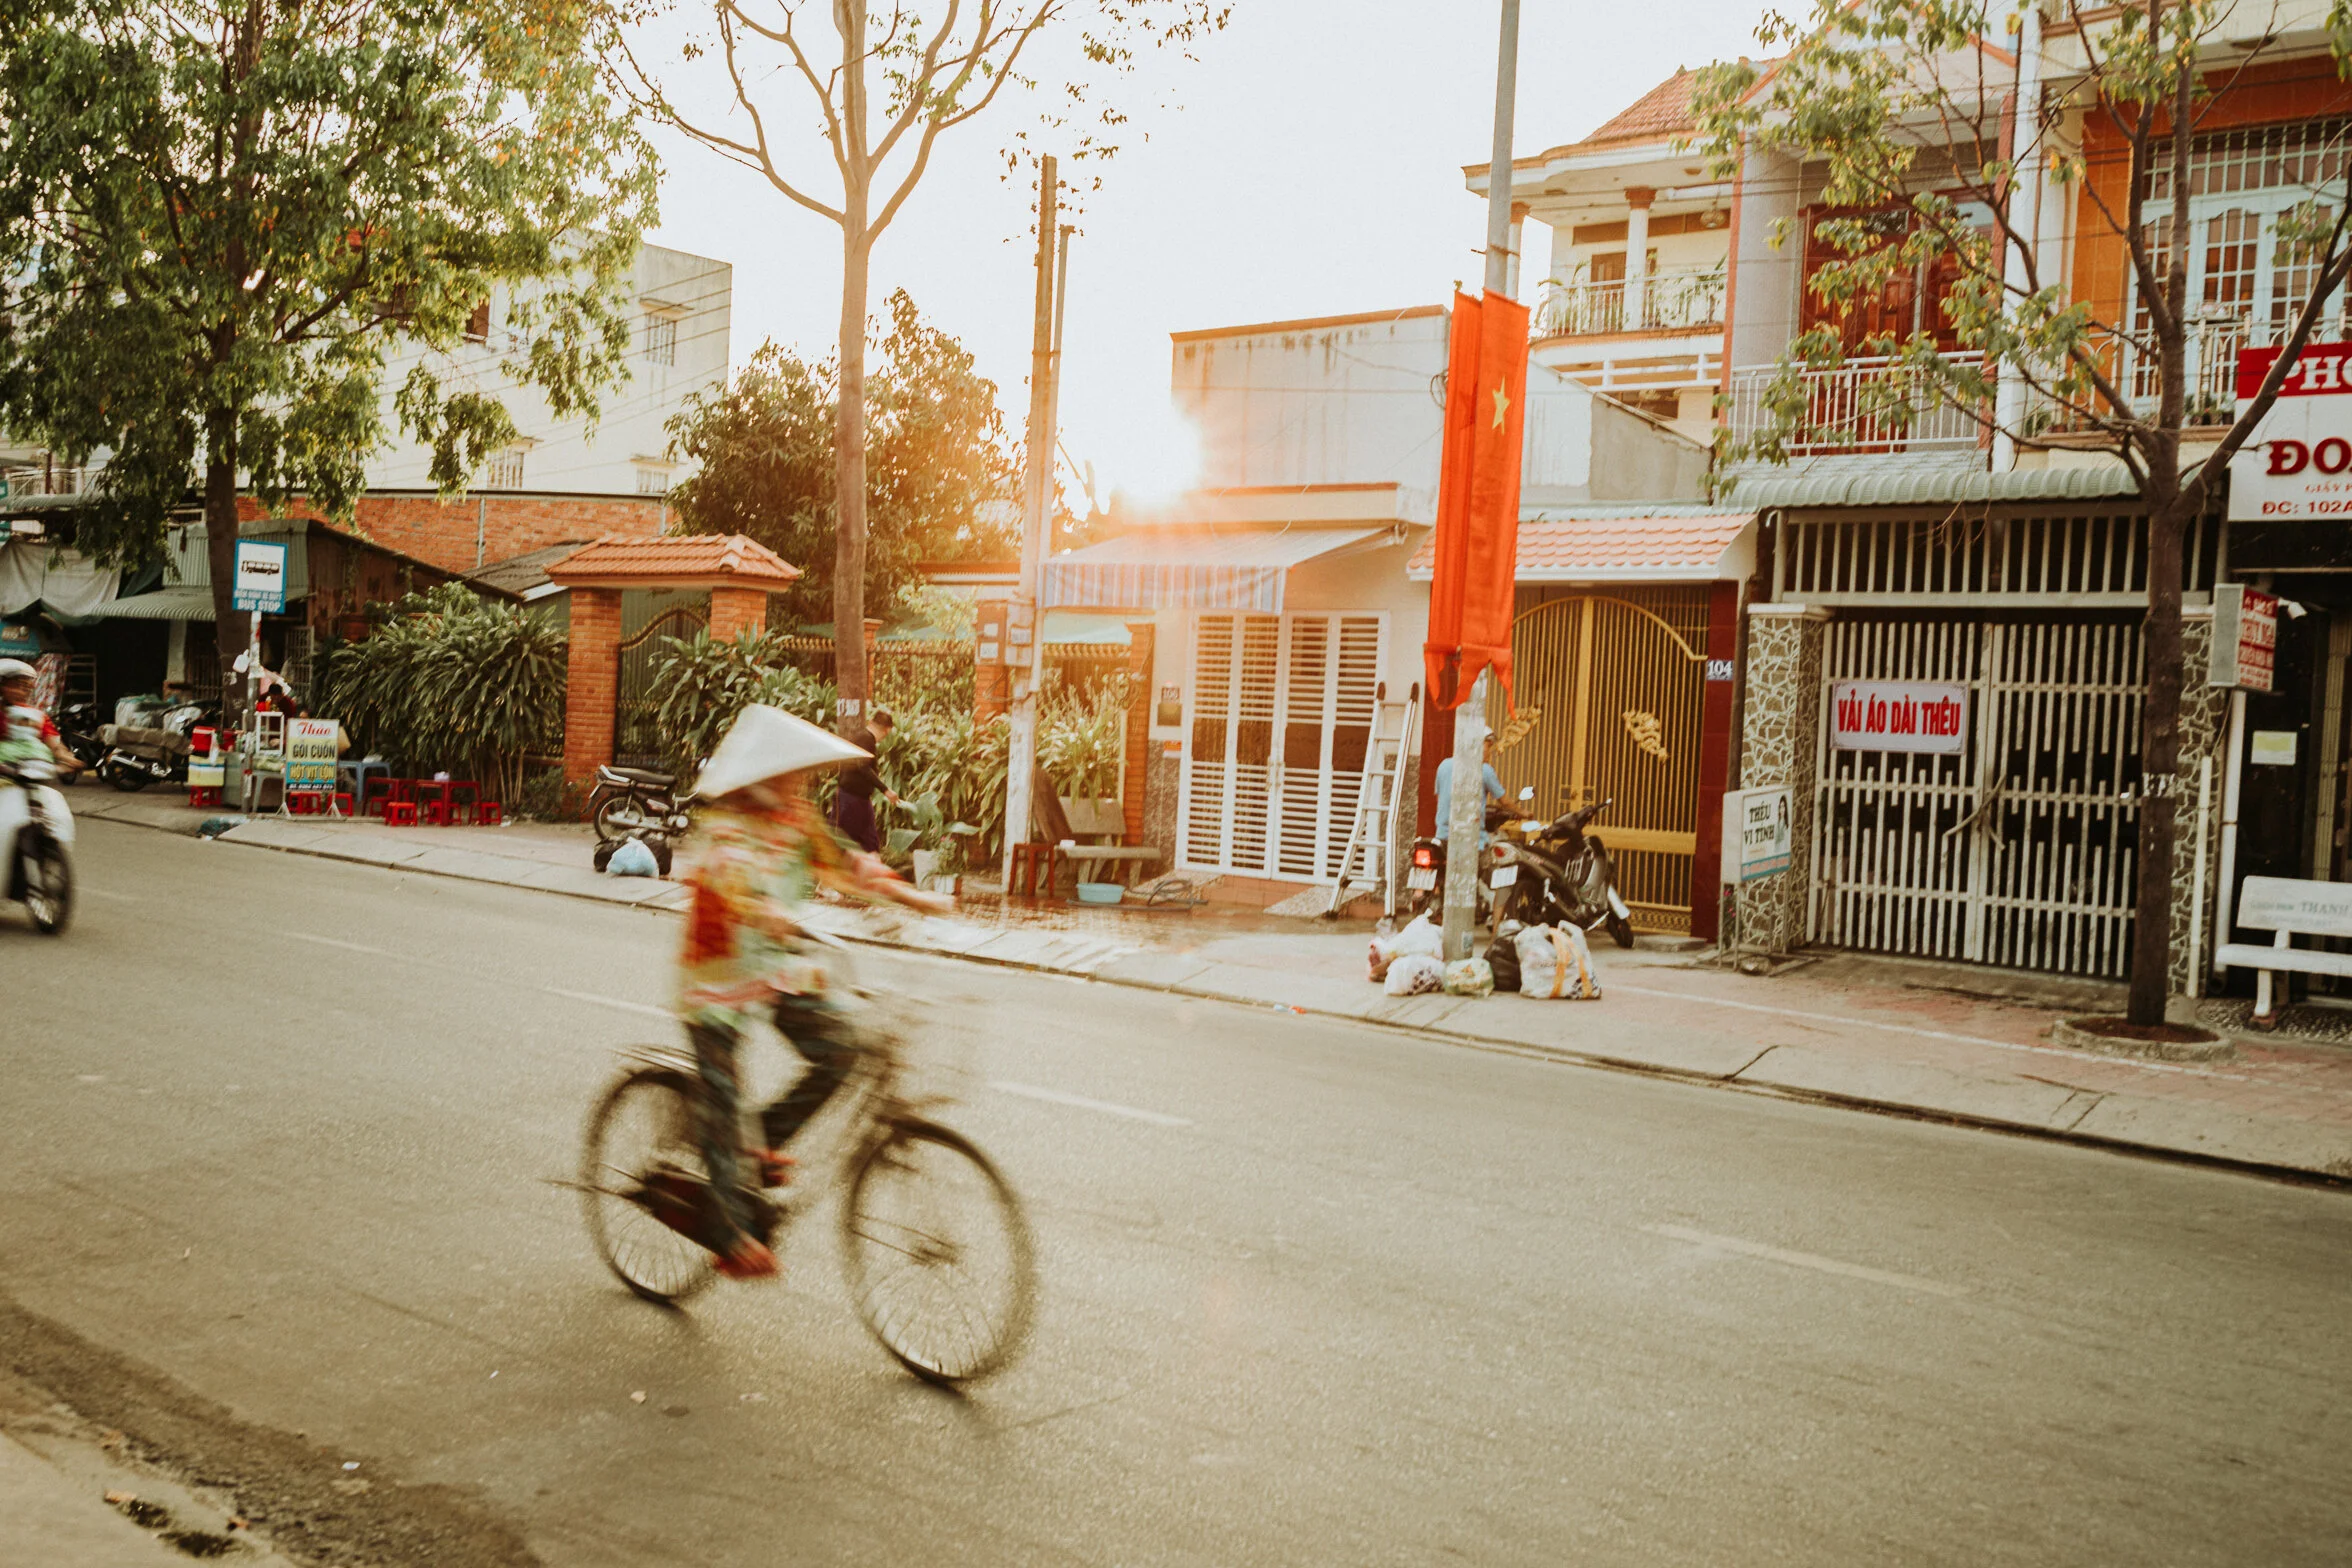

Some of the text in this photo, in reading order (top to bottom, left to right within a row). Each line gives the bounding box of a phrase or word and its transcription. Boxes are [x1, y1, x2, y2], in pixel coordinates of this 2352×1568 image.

[2266, 437, 2352, 475] ĐO
[238, 599, 281, 612] BUS STOP
[1708, 660, 1733, 677] 104
[1838, 688, 1961, 736] VẢI ÁO DÀI THÊU
[1744, 822, 1775, 845] VI TÍNH
